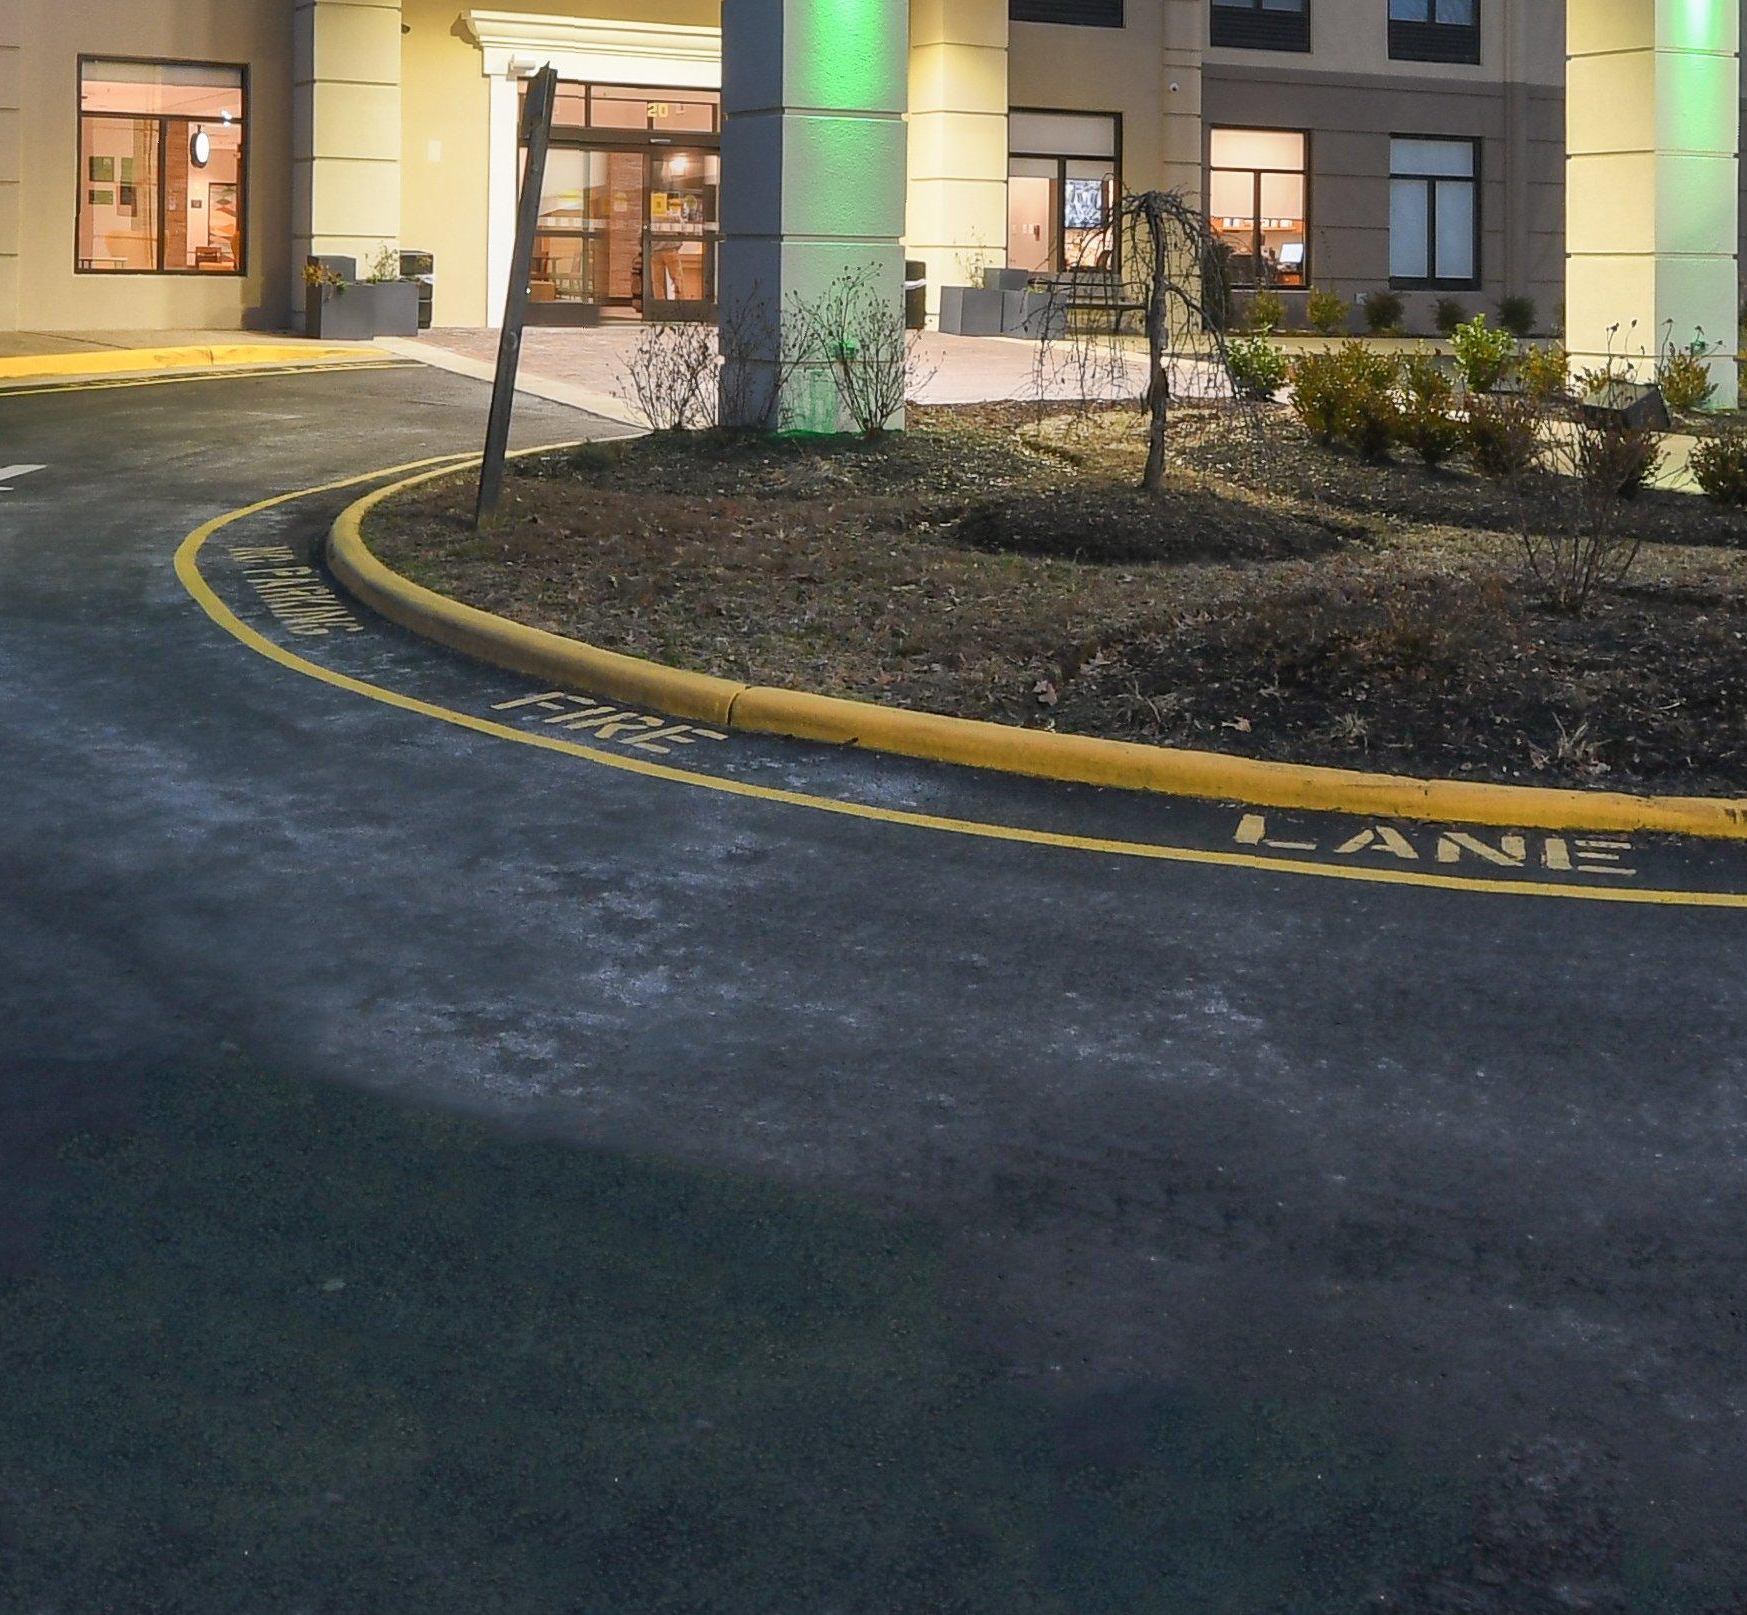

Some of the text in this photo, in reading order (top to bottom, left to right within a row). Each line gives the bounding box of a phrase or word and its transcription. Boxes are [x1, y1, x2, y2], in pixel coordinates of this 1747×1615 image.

[241, 566, 365, 635] PARKING
[490, 691, 730, 754] FIRE
[1233, 813, 1638, 876] LANE
